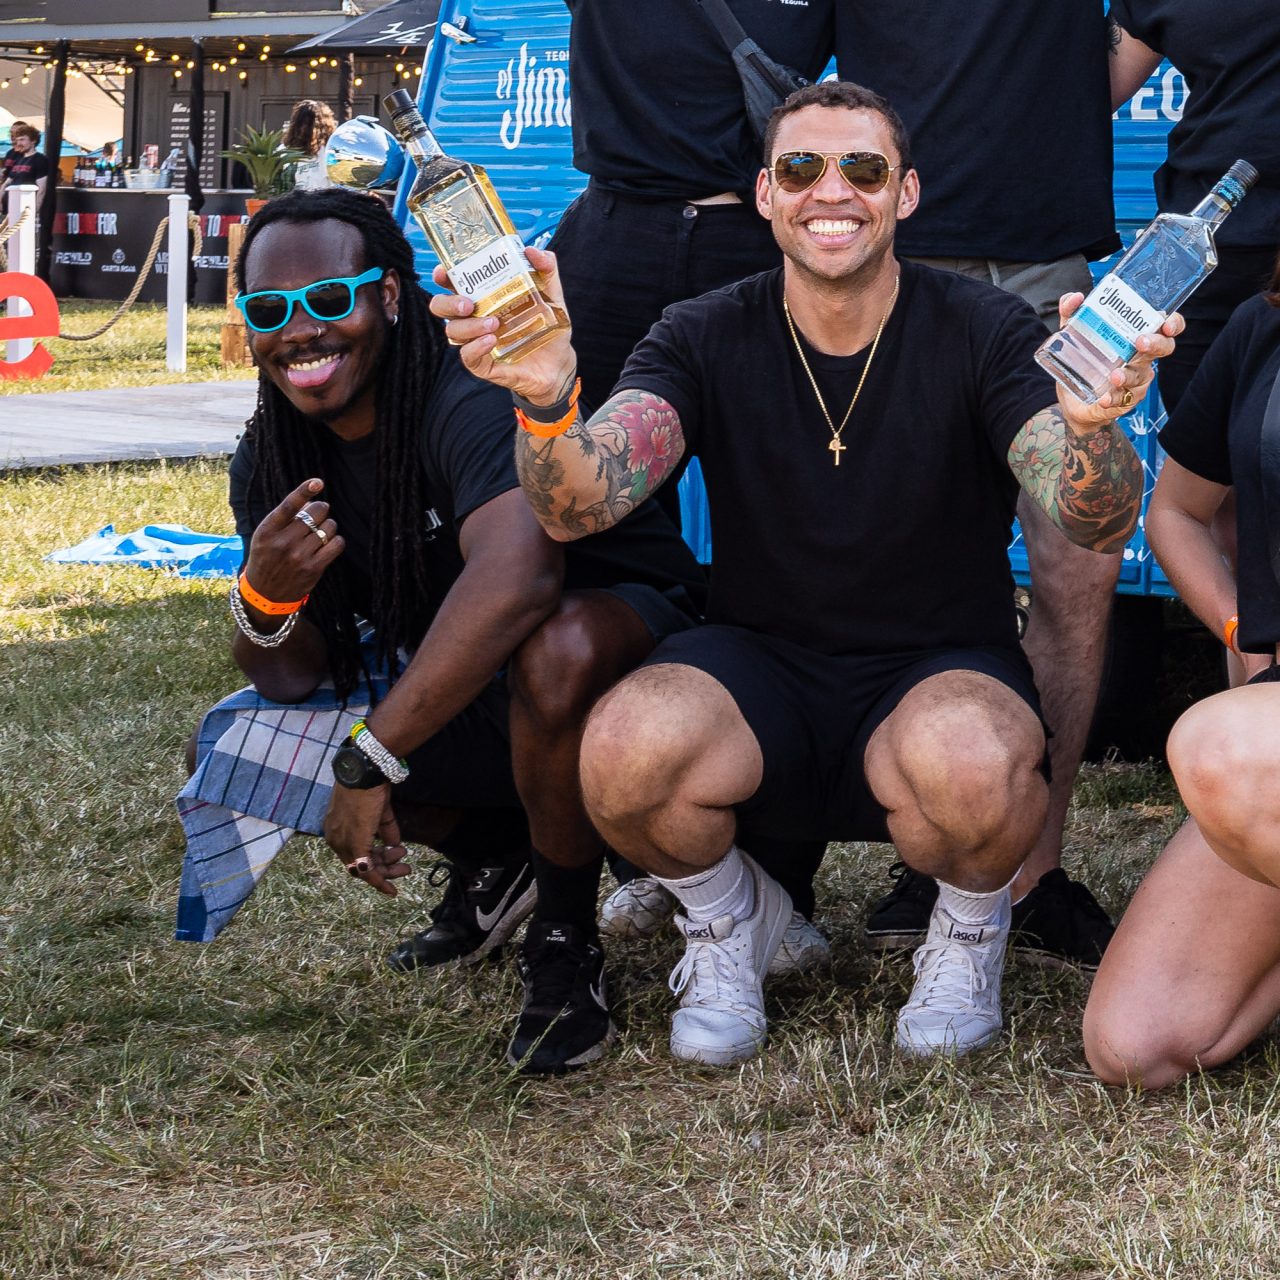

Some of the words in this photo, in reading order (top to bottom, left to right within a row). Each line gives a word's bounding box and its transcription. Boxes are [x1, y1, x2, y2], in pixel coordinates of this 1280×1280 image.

[496, 58, 514, 99] el
[457, 275, 465, 287] el
[463, 251, 510, 295] Jimador
[1103, 287, 1112, 295] el
[1099, 288, 1150, 332] Jimador
[953, 931, 979, 941] asics
